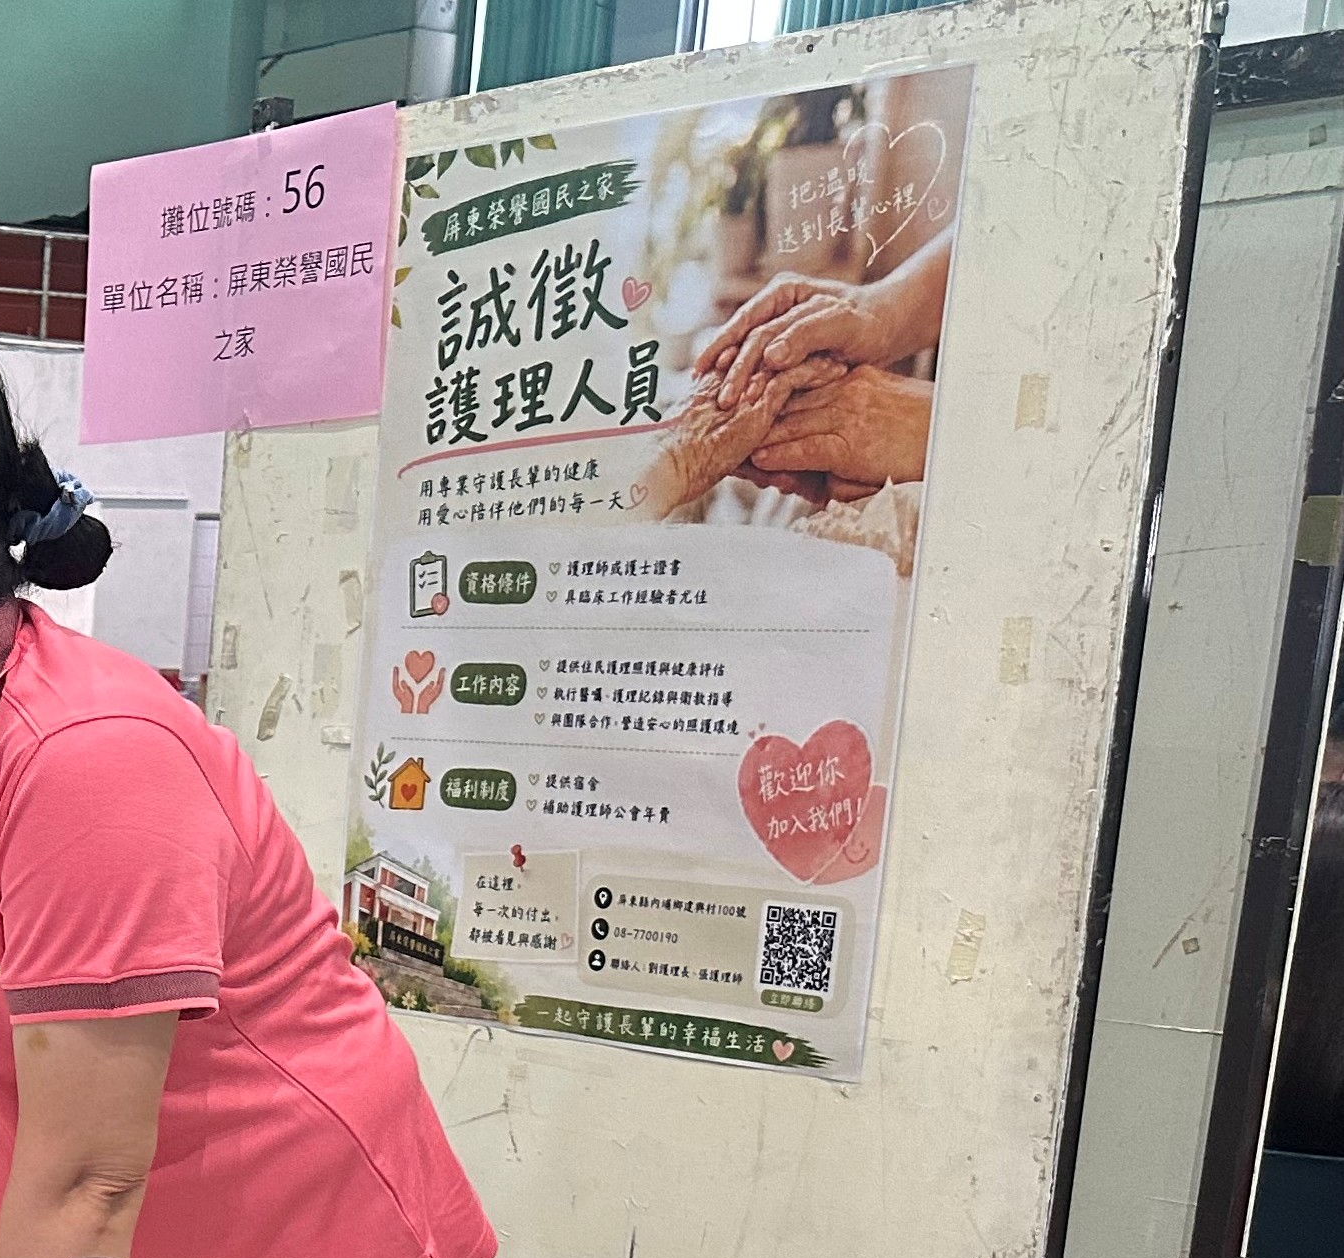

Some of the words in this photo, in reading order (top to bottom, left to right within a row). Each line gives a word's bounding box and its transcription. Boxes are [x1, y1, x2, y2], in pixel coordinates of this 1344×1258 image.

[789, 160, 875, 209] 把溫暖
[443, 173, 617, 243] 屏東榮譽國民之家
[438, 238, 628, 372] 誠徵
[213, 326, 256, 361] 之家
[424, 339, 663, 447] 護理人員
[419, 458, 600, 498] 用專業守護長輩的健康
[418, 491, 625, 526] 用愛心陪伴他們的每一天
[465, 570, 532, 596] 資格條件
[456, 671, 521, 697] 工作內容
[445, 777, 511, 803] 福利制度
[545, 774, 600, 791] 提供宿舍
[759, 756, 846, 803] 歡迎你
[469, 927, 557, 950] 都被看見與感謝
[613, 926, 679, 944] 08-7700190
[537, 1004, 766, 1054] 一起守護長輩的幸福生活
